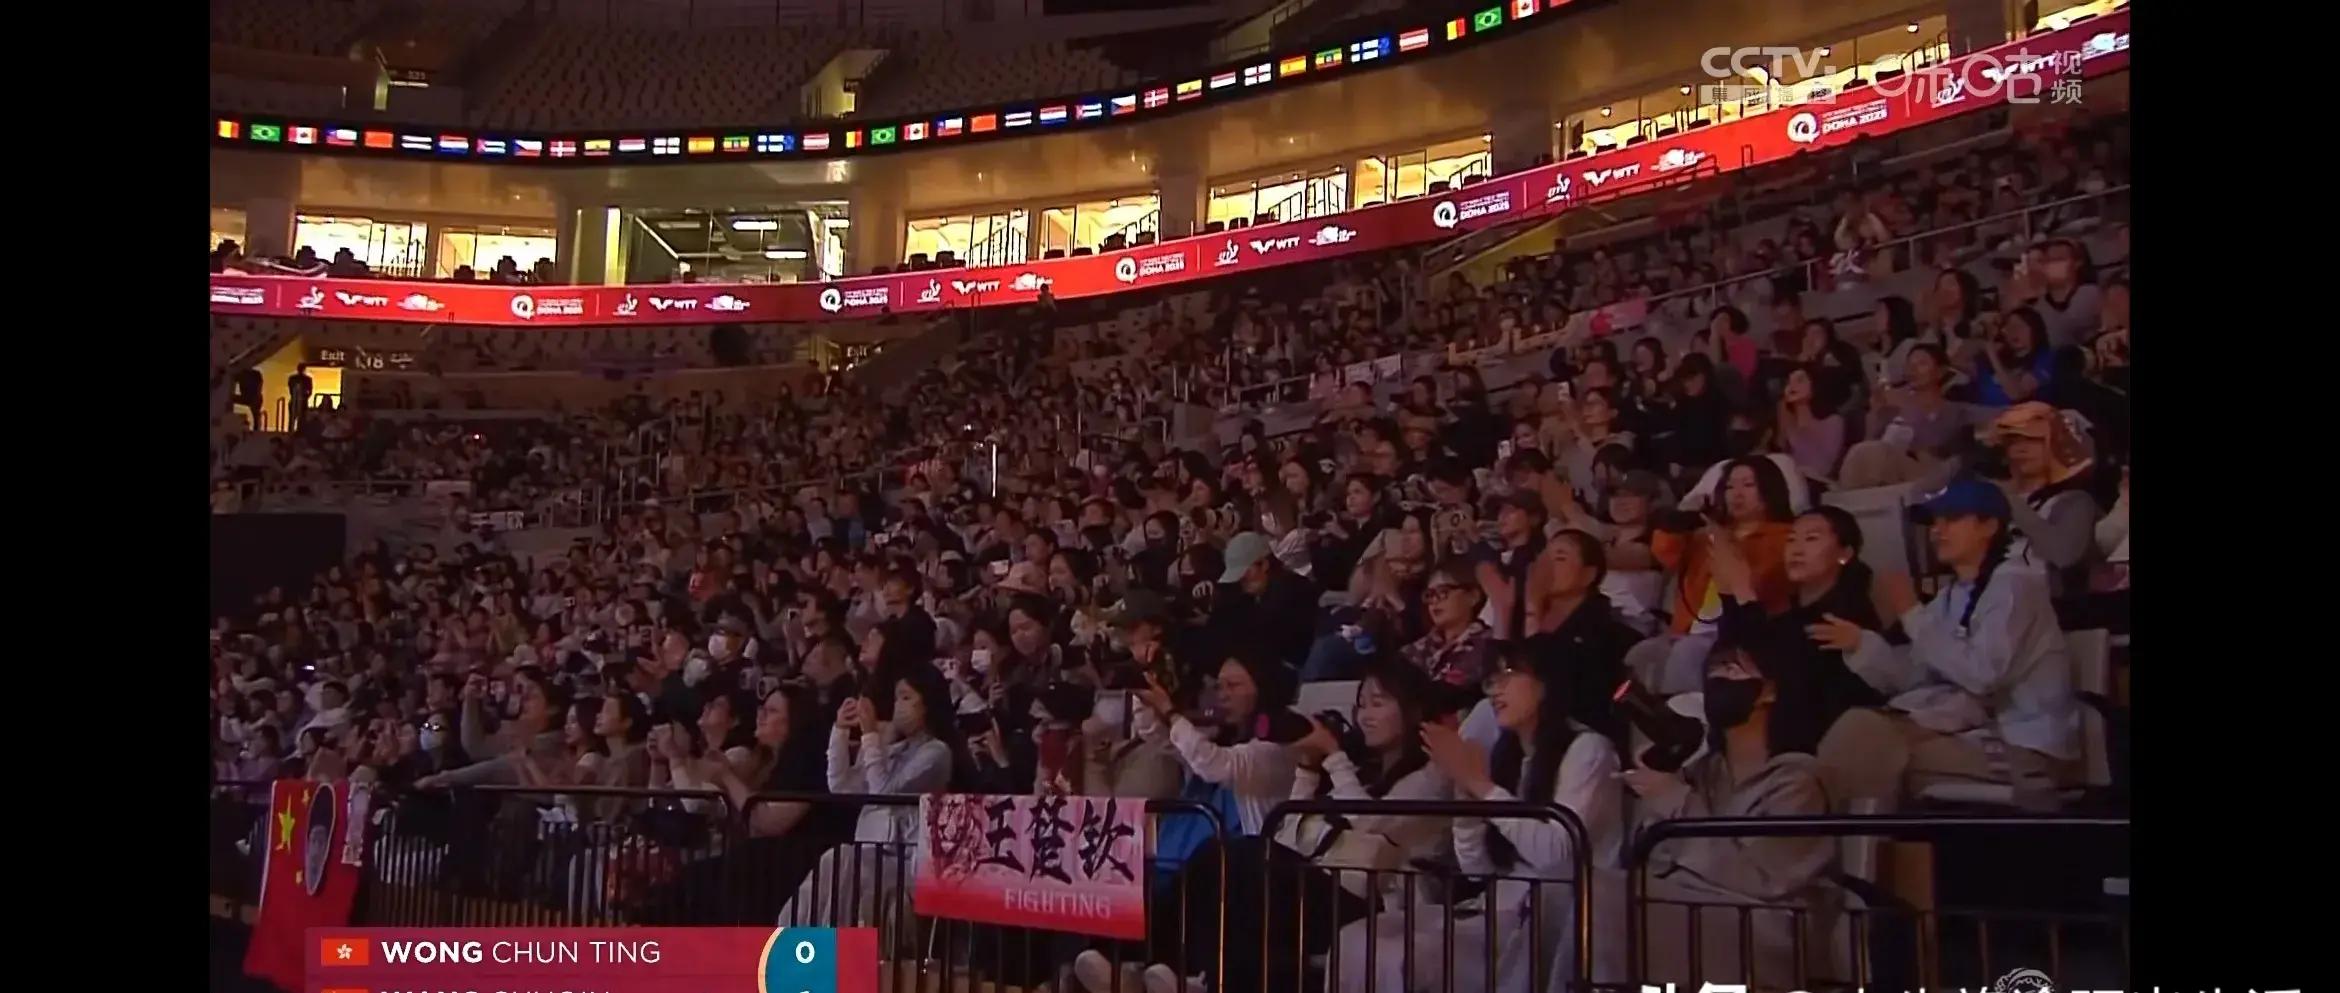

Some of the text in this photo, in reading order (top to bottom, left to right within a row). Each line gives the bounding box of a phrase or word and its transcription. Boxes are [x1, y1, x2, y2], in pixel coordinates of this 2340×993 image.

[1822, 119, 1857, 135] DOHA
[1613, 163, 1641, 179] WTT
[1460, 207, 1487, 220] DOHA
[1276, 236, 1300, 250] WTT
[977, 280, 1001, 293] WTT
[321, 348, 345, 361] Exit
[975, 796, 1135, 885] 王楚钦
[1004, 888, 1112, 920] FIGHTING
